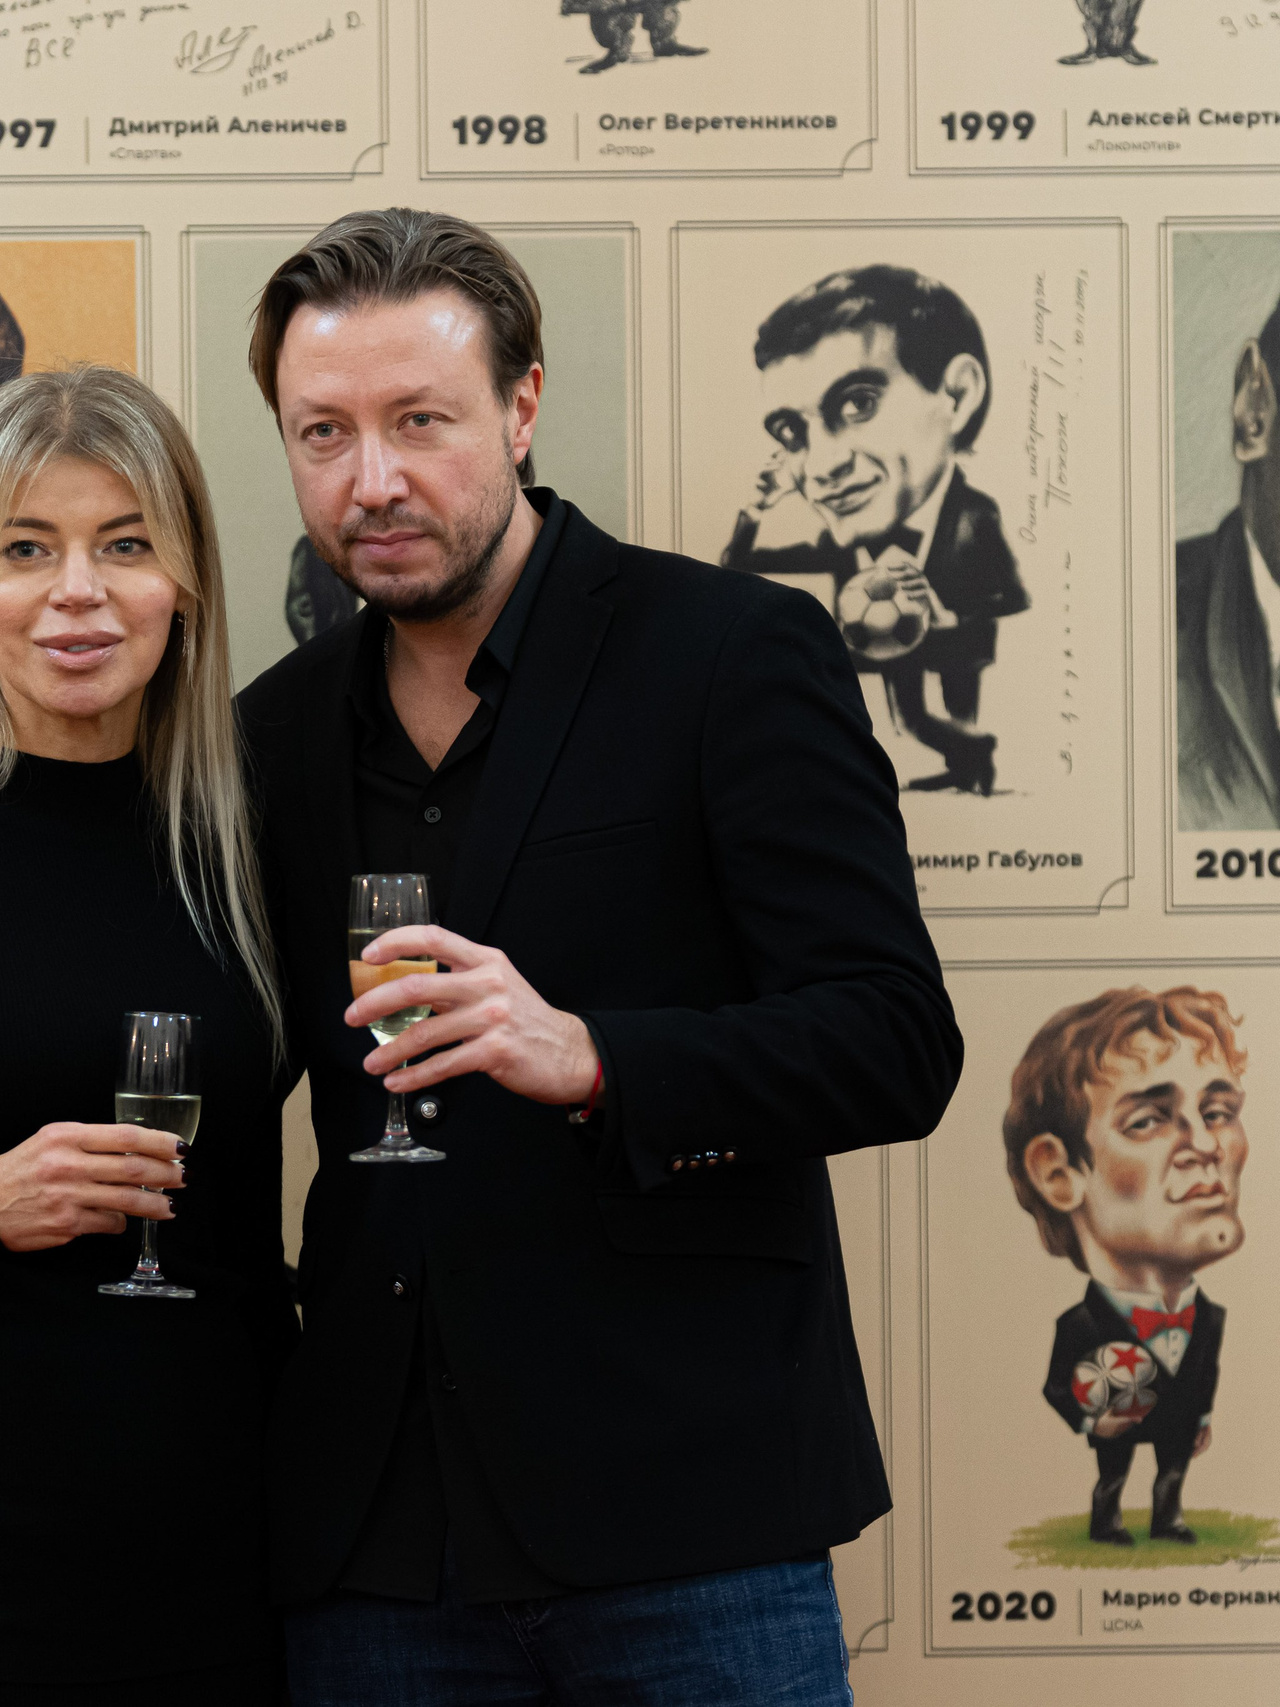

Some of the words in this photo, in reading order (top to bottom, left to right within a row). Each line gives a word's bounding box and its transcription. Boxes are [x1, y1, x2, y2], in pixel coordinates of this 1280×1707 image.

[108, 115, 220, 139] Дмитрий
[227, 116, 348, 134] Аленичев
[598, 113, 657, 132] Олег
[663, 112, 838, 134] Веретенников
[940, 110, 1037, 141] 1999
[1087, 107, 1191, 127] Алексей
[451, 114, 548, 146] 1998
[987, 849, 1083, 871] Габулов
[950, 1590, 1058, 1622] 2020
[1101, 1589, 1182, 1609] Марио
[1101, 1617, 1144, 1634] ЦСКА
